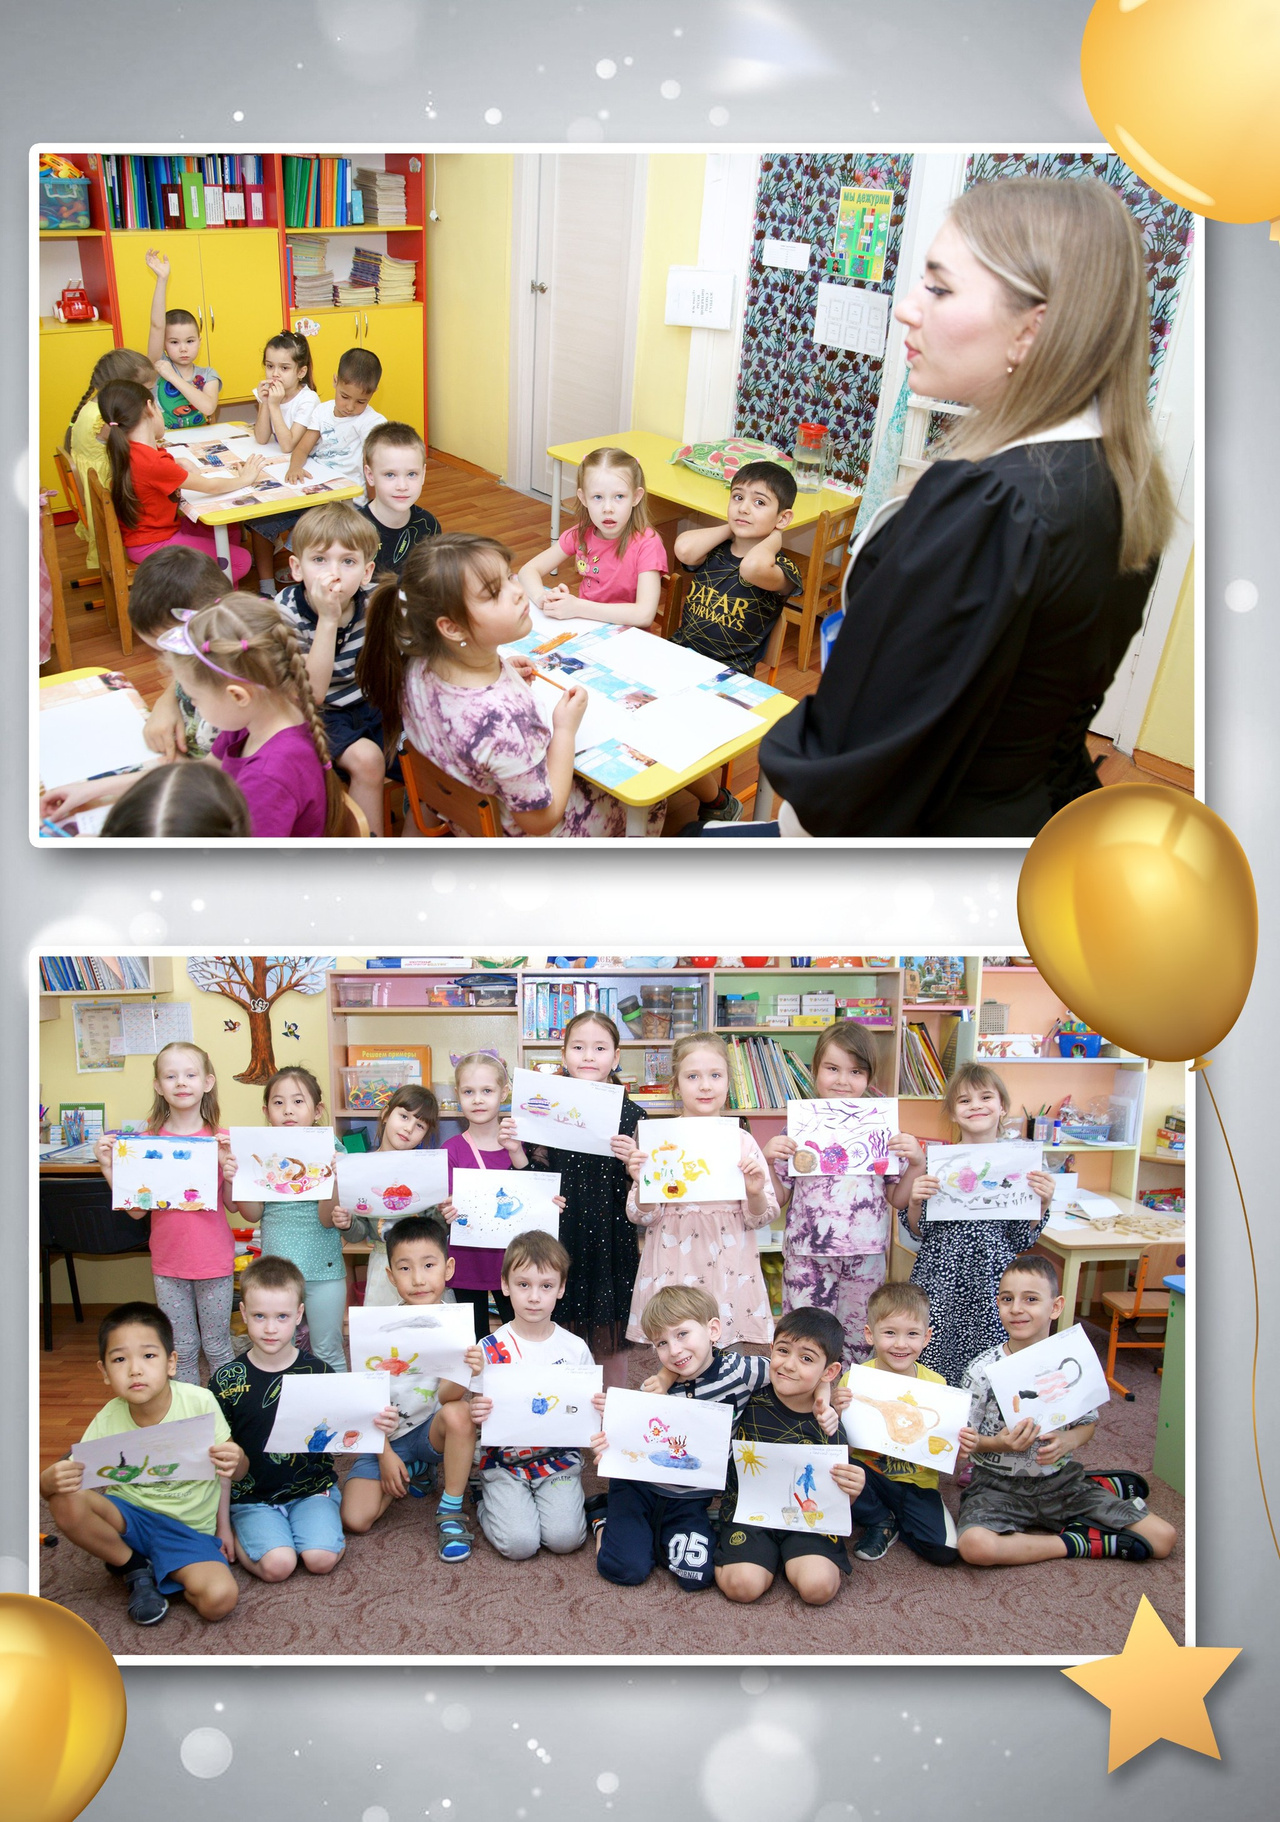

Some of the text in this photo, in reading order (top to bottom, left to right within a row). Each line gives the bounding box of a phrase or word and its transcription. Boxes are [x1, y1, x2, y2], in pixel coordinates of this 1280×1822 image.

[857, 193, 891, 207] дежурим
[688, 602, 745, 632] AIRWAYS
[362, 1050, 417, 1060] Решаем примеры
[668, 1531, 709, 1568] 05
